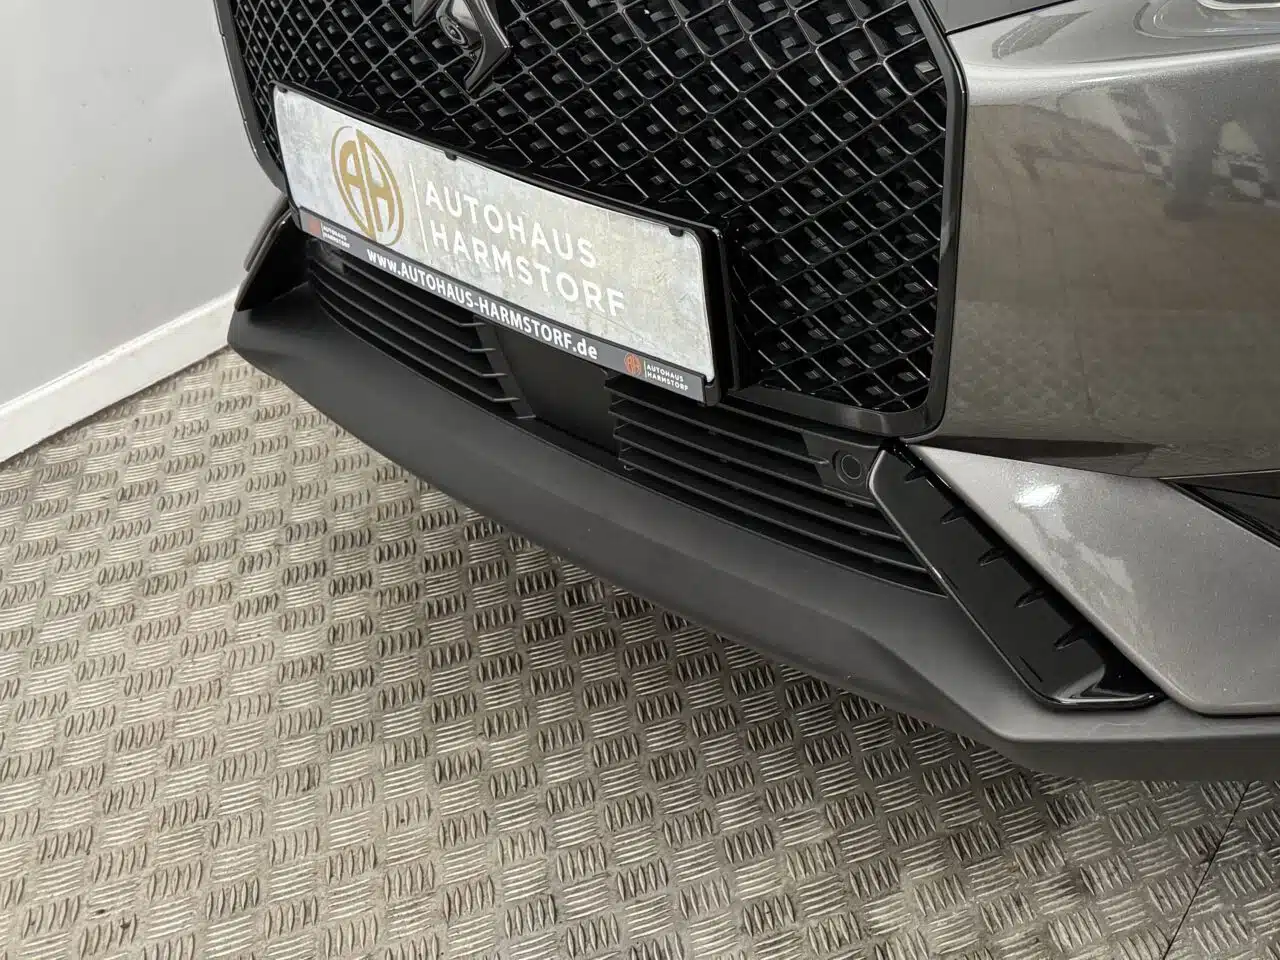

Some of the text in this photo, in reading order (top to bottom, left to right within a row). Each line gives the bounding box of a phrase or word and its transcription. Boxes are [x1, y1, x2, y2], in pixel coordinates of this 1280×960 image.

[425, 179, 598, 269] AUTOHAUS
[430, 219, 626, 318] HARMSTORF
[366, 249, 598, 361] www.AUTOHAUS-HARMSTORF.de
[646, 363, 684, 382] AUTOHAUS
[647, 371, 689, 391] HARMSTORF
